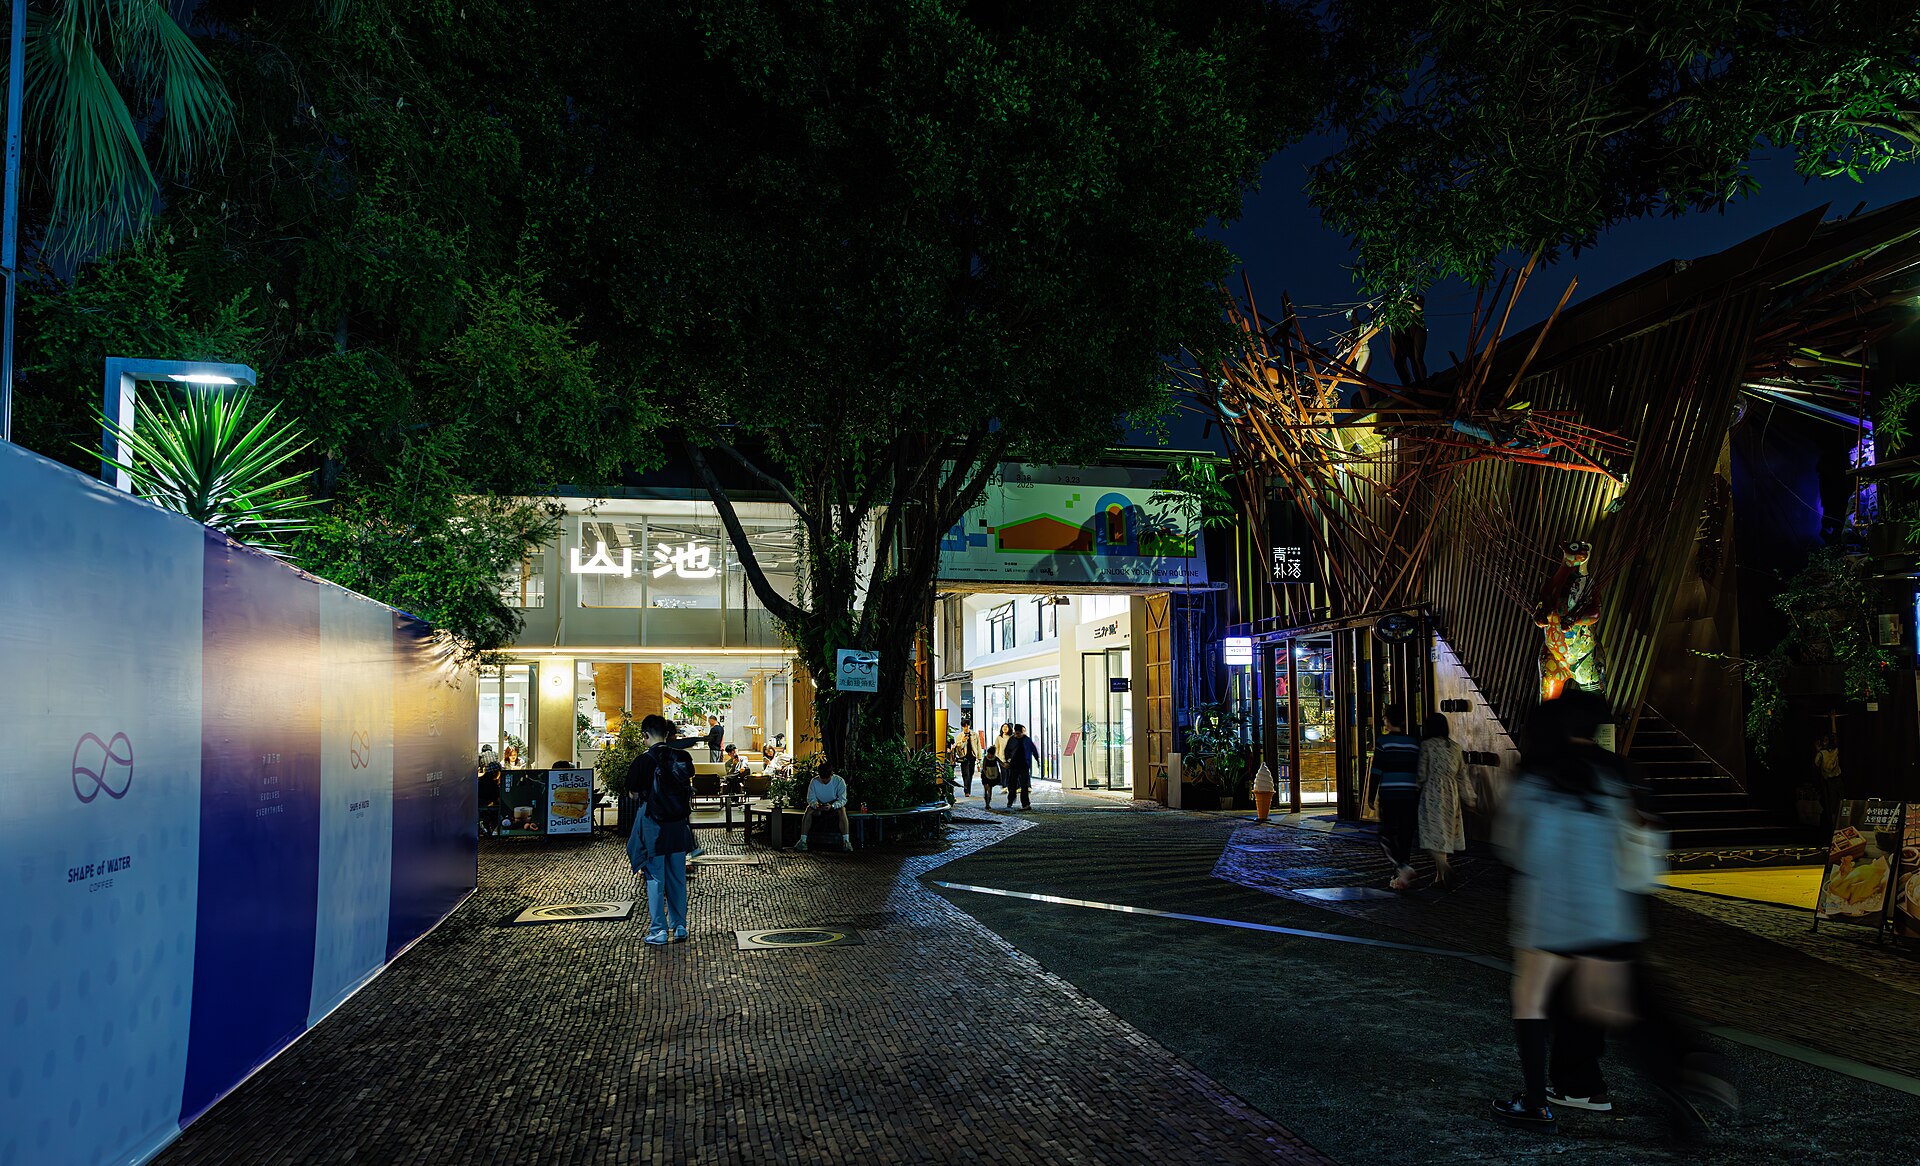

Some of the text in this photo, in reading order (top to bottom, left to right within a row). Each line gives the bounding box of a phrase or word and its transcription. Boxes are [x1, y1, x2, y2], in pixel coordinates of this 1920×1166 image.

[570, 541, 716, 579] 山池
[1101, 568, 1130, 576] UNLOCK
[1151, 569, 1168, 577] NEW
[550, 816, 590, 827] Delicious!
[67, 855, 131, 883] SHAPE of WATER
[88, 878, 114, 893] COFFEE
